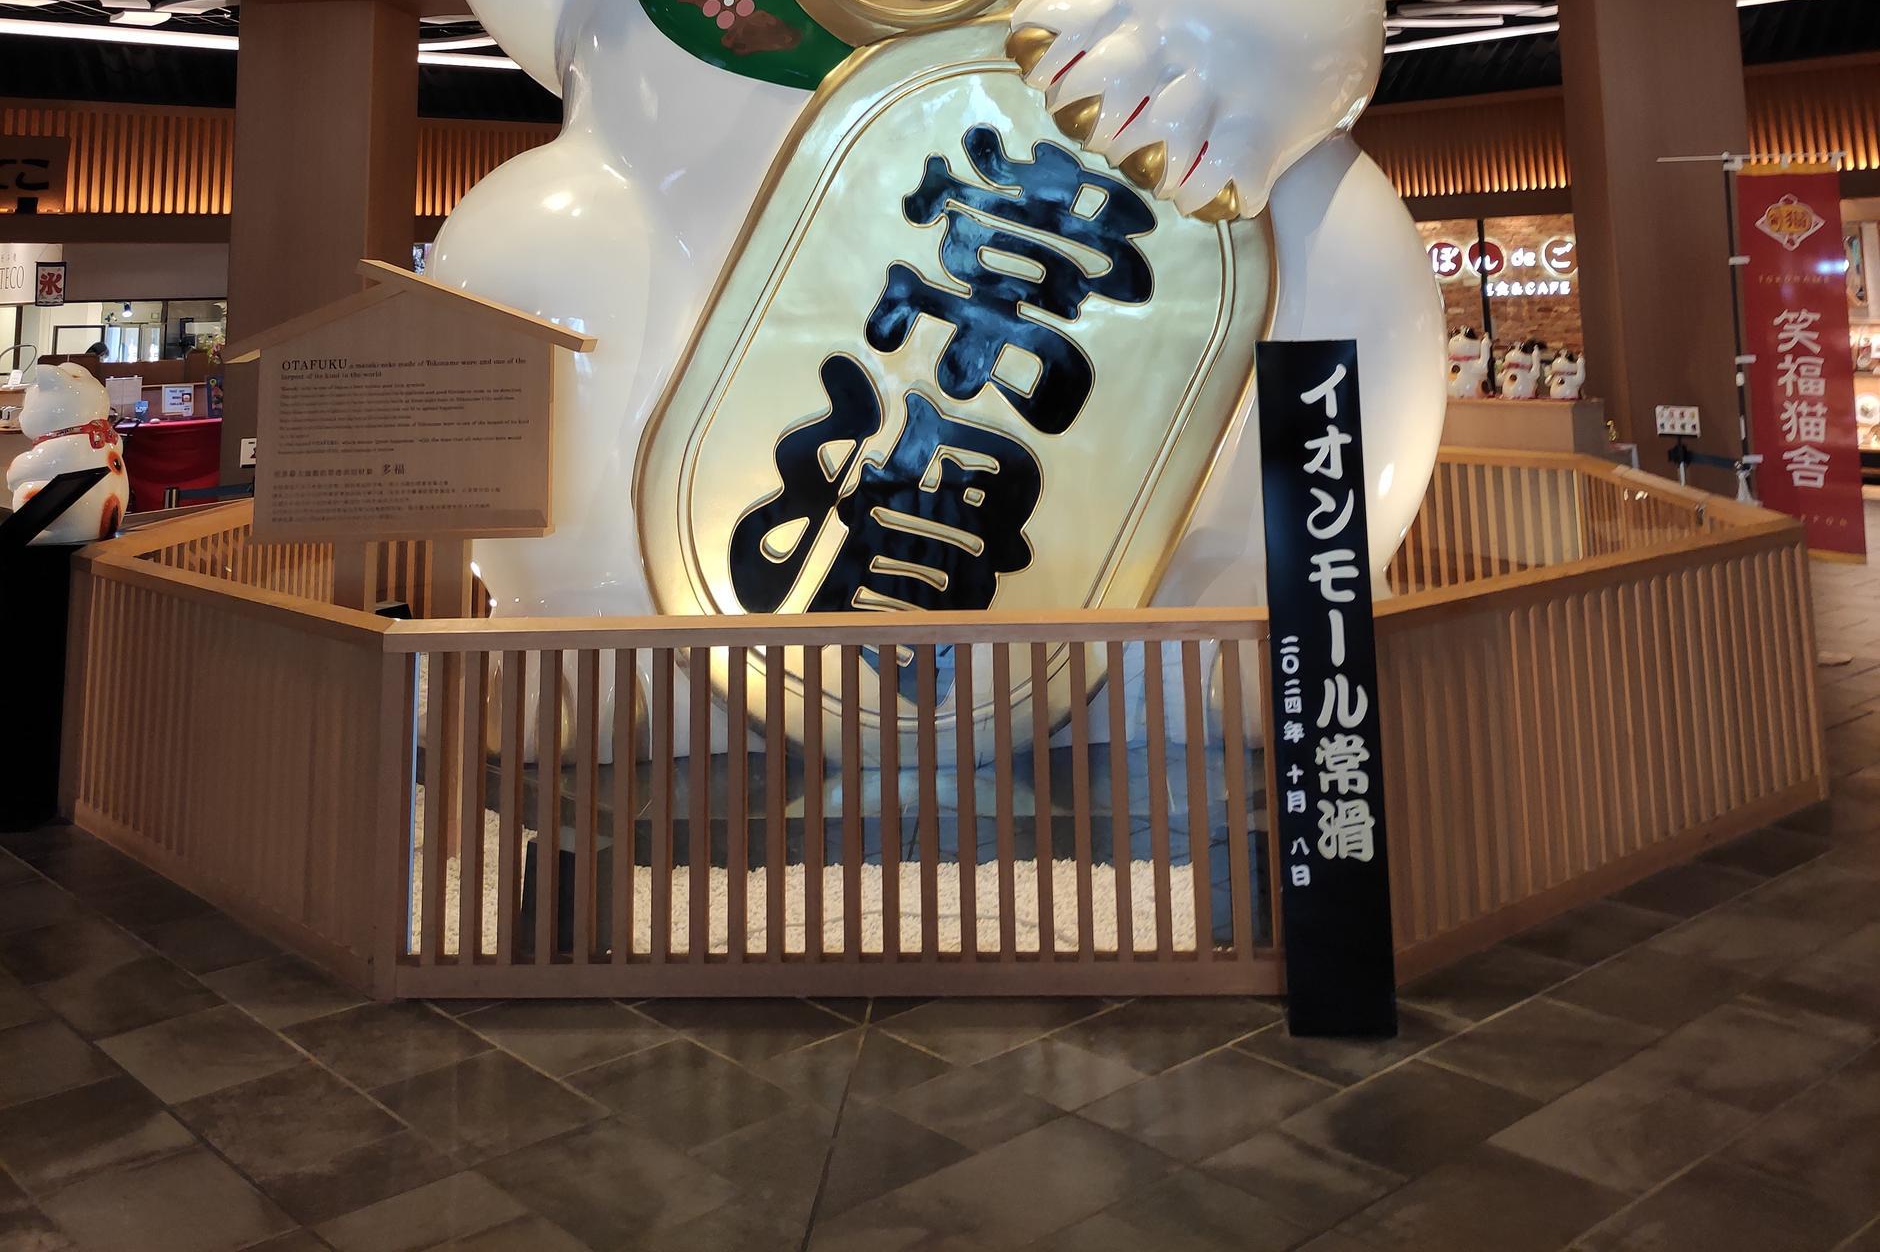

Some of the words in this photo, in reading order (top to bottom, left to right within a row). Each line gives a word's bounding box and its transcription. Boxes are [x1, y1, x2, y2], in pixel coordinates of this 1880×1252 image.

[39, 272, 62, 295] 氷
[282, 358, 347, 371] OTAFUKU
[1300, 363, 1375, 863] イオンモール常滑
